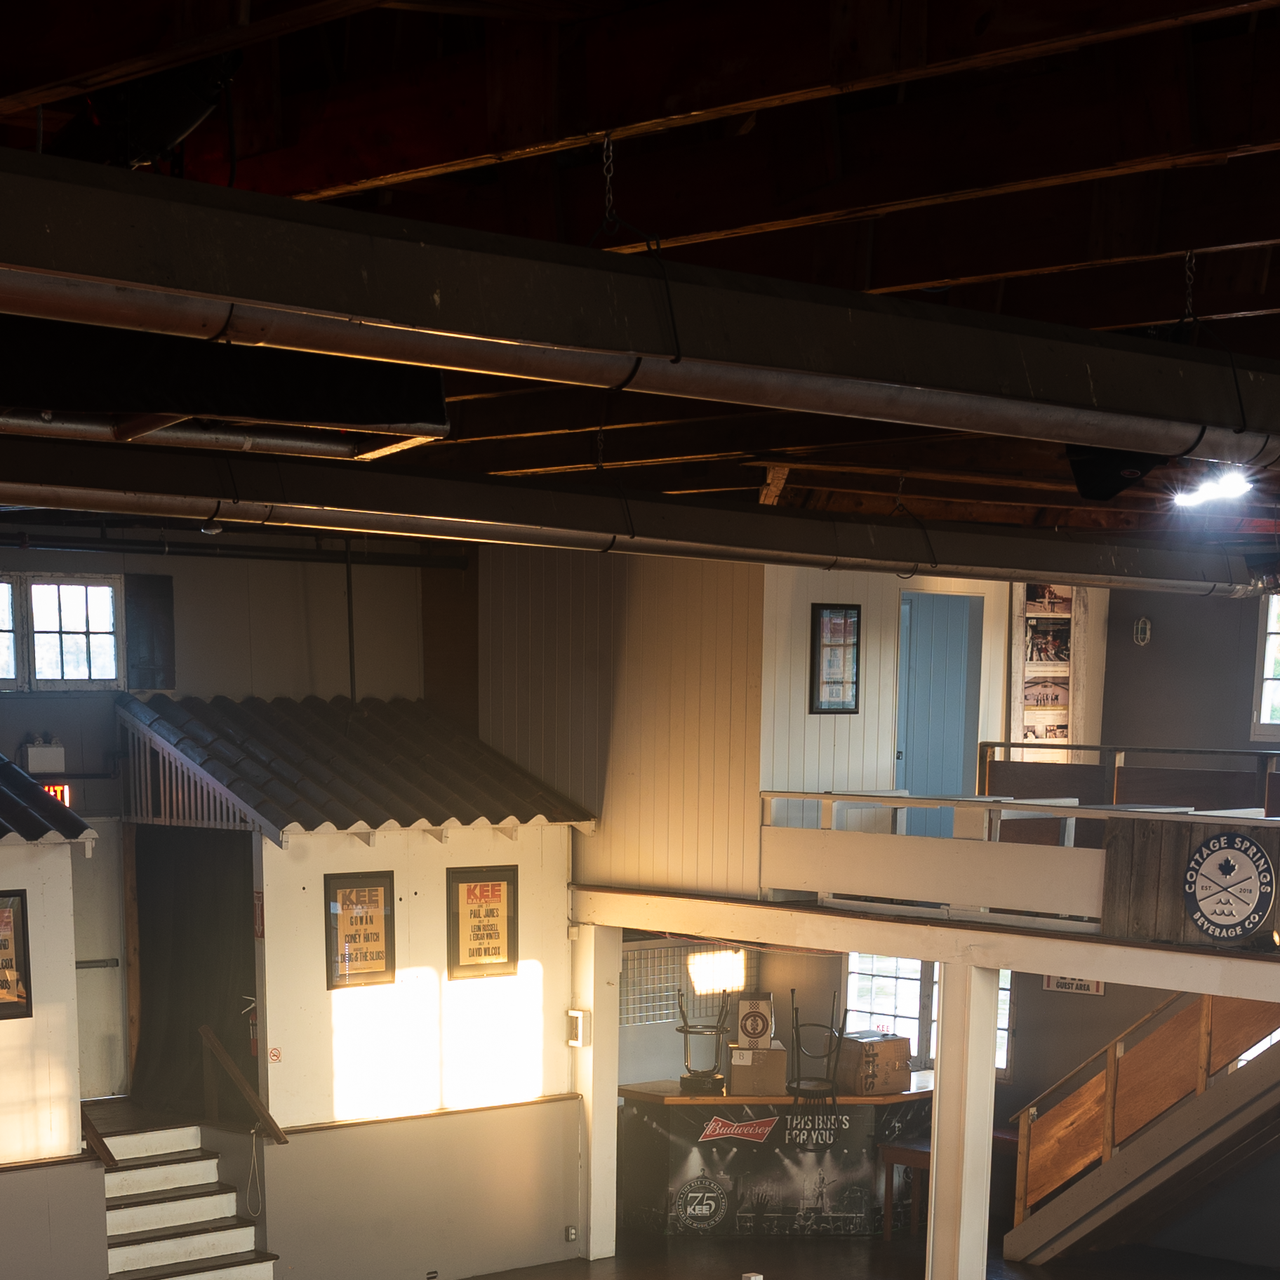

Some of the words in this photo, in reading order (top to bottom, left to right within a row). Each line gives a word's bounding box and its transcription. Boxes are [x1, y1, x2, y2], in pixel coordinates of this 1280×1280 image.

[1185, 836, 1228, 893] COTTAGE
[1234, 837, 1271, 893] SPRINGS
[342, 889, 379, 904] KEE
[467, 883, 501, 898] KEE
[350, 915, 374, 926] GOWAN
[1193, 911, 1242, 937] BEVERAGE
[1245, 912, 1262, 928] CO.
[345, 934, 361, 944] CONEY
[363, 932, 380, 943] HATCH
[1056, 981, 1074, 990] GUEST
[1075, 983, 1091, 992] AREA
[703, 1120, 772, 1136] Budweiser
[785, 1115, 812, 1129] THIS
[815, 1115, 850, 1129] BUD'S
[785, 1130, 808, 1144] FOR
[811, 1130, 834, 1144] YOU
[687, 1192, 717, 1214] 75
[687, 1205, 710, 1216] KEE
